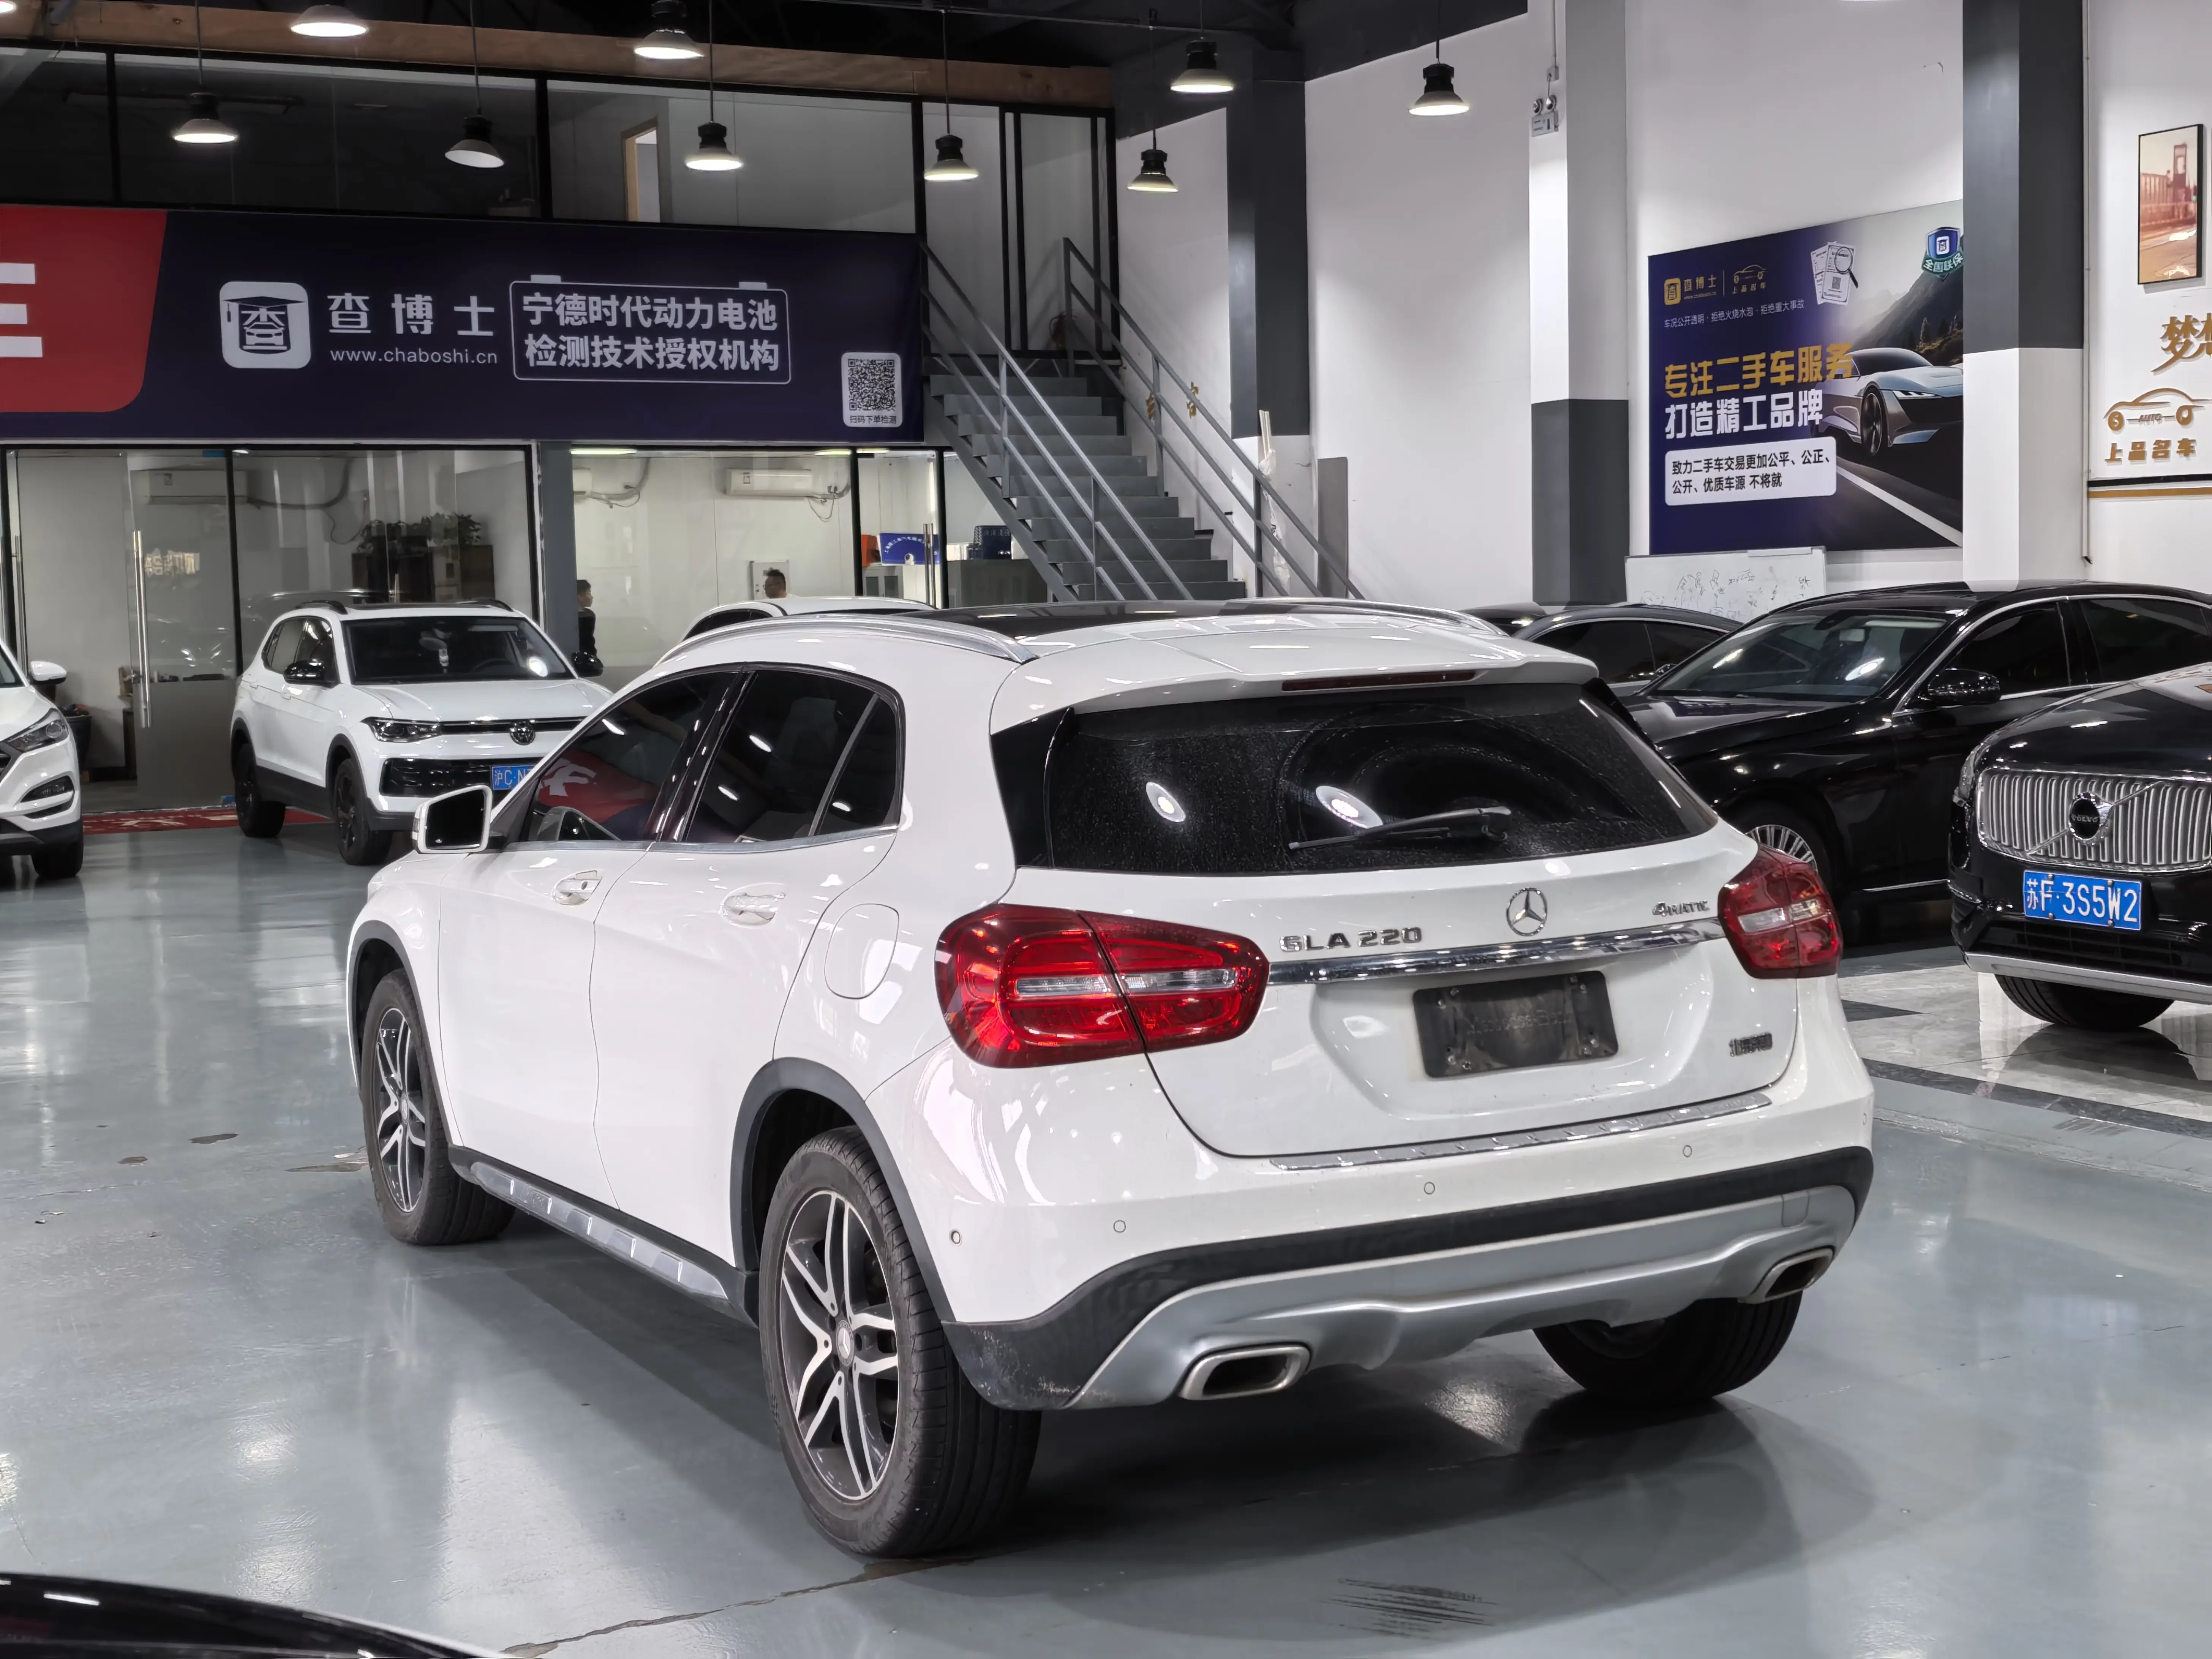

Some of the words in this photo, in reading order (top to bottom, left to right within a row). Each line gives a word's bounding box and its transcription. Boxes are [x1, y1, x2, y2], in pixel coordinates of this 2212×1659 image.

[327, 292, 495, 336] 查博士
[523, 292, 778, 331] 宁德时代动力电池
[330, 348, 497, 363] www.chaboshi.cn
[525, 334, 779, 371] 检测技术授权机构
[1665, 343, 1853, 398] 专注二手车服务
[850, 415, 896, 424] 扫码下单检测
[1665, 389, 1823, 439] 打造精工品牌
[2105, 438, 2196, 462] 上品名车
[1749, 472, 1782, 489] 不将就
[2071, 814, 2098, 823] VOLVO
[1279, 932, 1351, 952] GLA
[1357, 927, 1422, 947] 220
